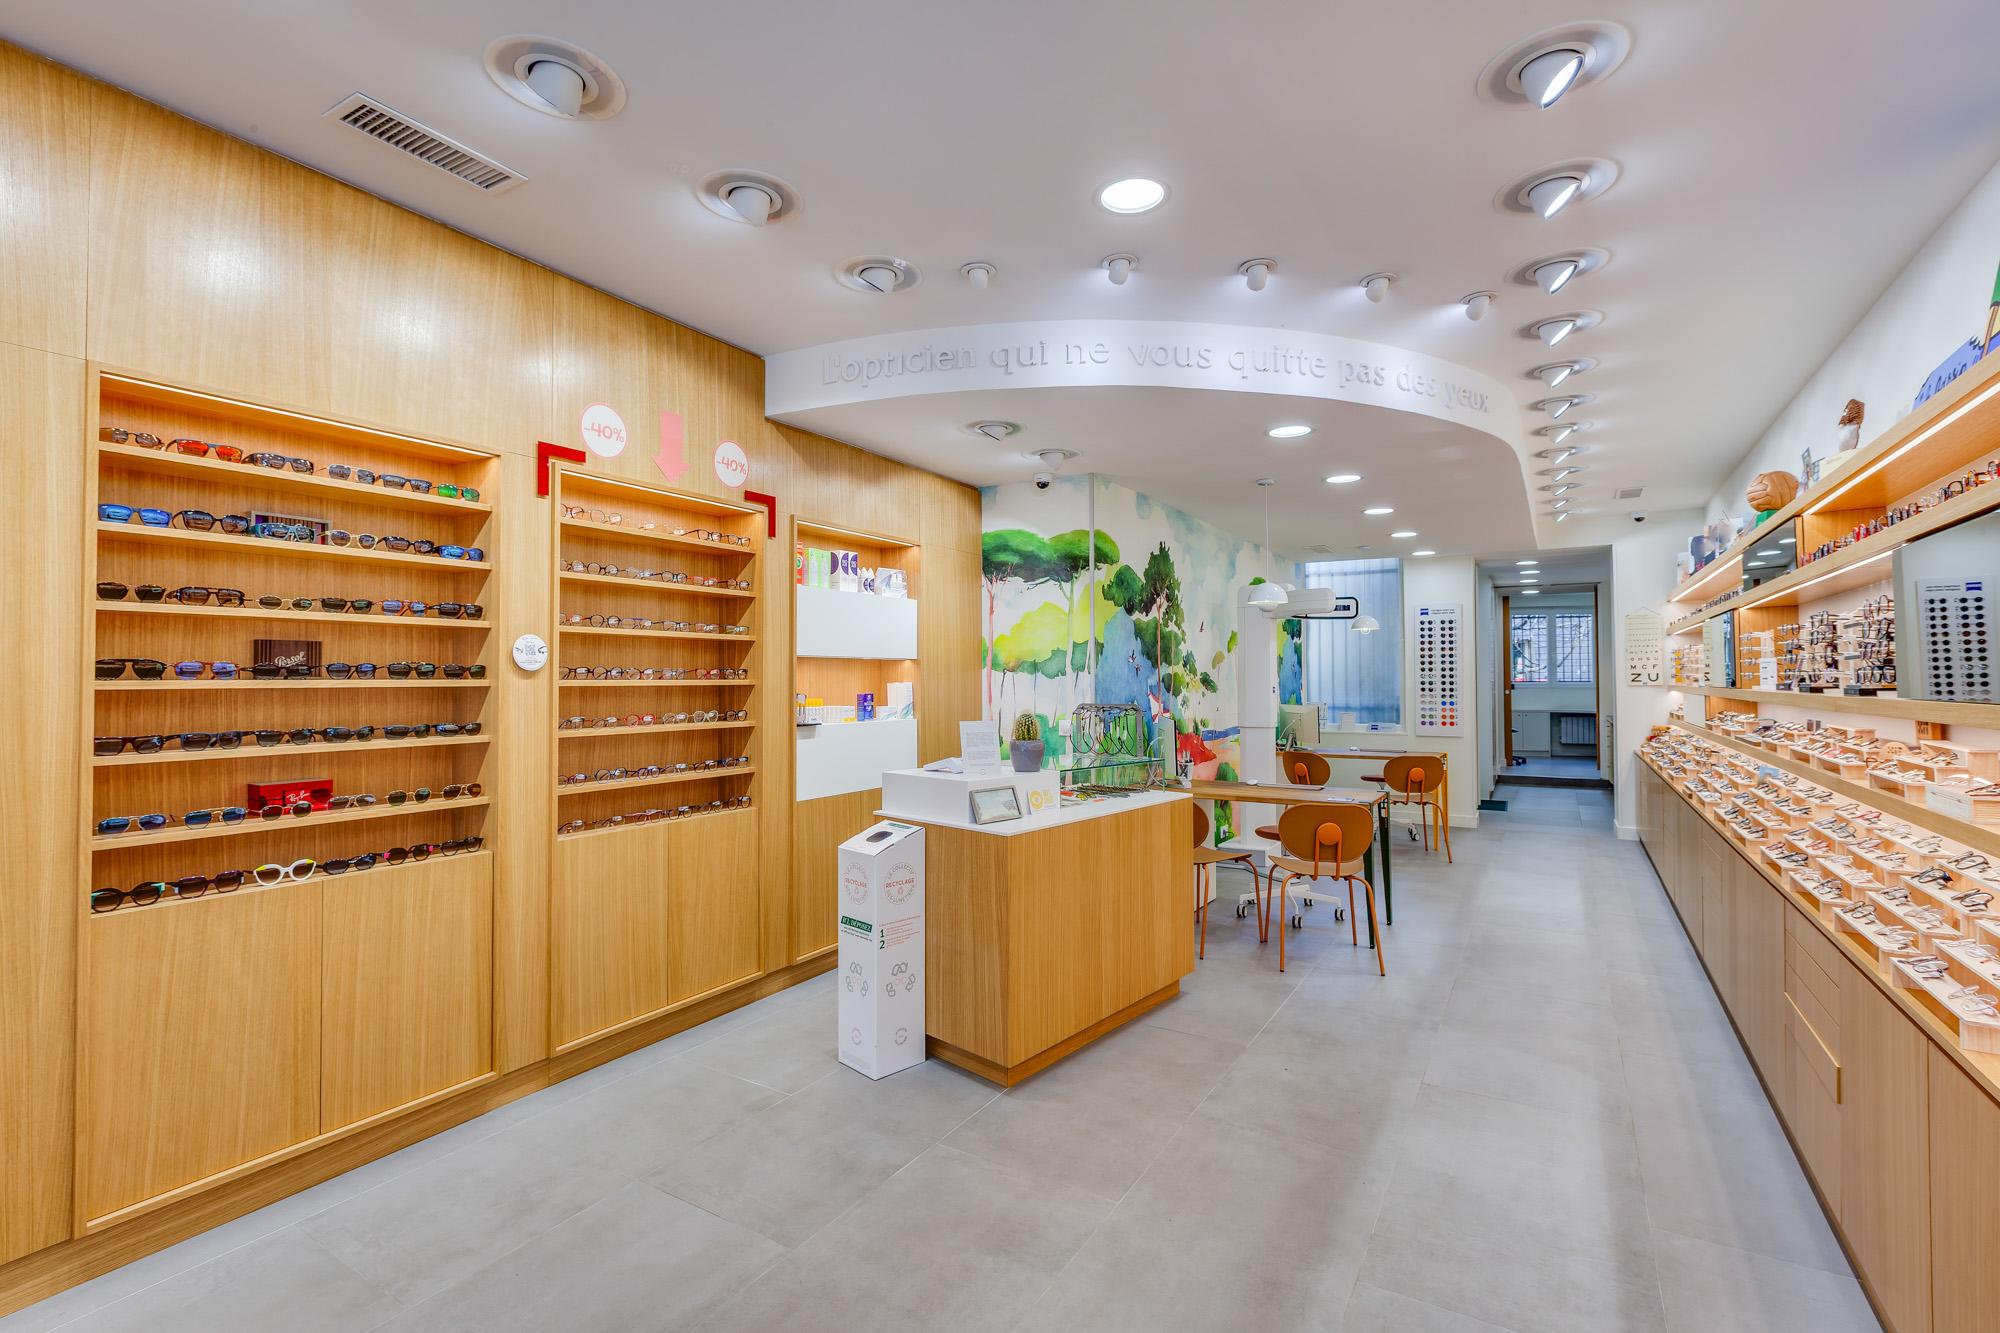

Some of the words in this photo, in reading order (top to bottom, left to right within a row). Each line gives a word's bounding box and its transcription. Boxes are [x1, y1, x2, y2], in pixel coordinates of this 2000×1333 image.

[820, 344, 977, 388] L'opticien
[990, 339, 1049, 375] qui
[1065, 341, 1110, 365] ne
[1128, 344, 1212, 369] vous
[1228, 345, 1327, 380] quitte
[1337, 359, 1386, 389] pas
[1396, 360, 1436, 397] des
[1444, 379, 1490, 413] yeux
[584, 421, 625, 442] -40%
[716, 458, 747, 475] -40%
[274, 651, 307, 668] Persol
[1631, 673, 1642, 682] Z
[1648, 673, 1659, 682] U
[879, 929, 885, 938] 1
[879, 940, 886, 949] 2
